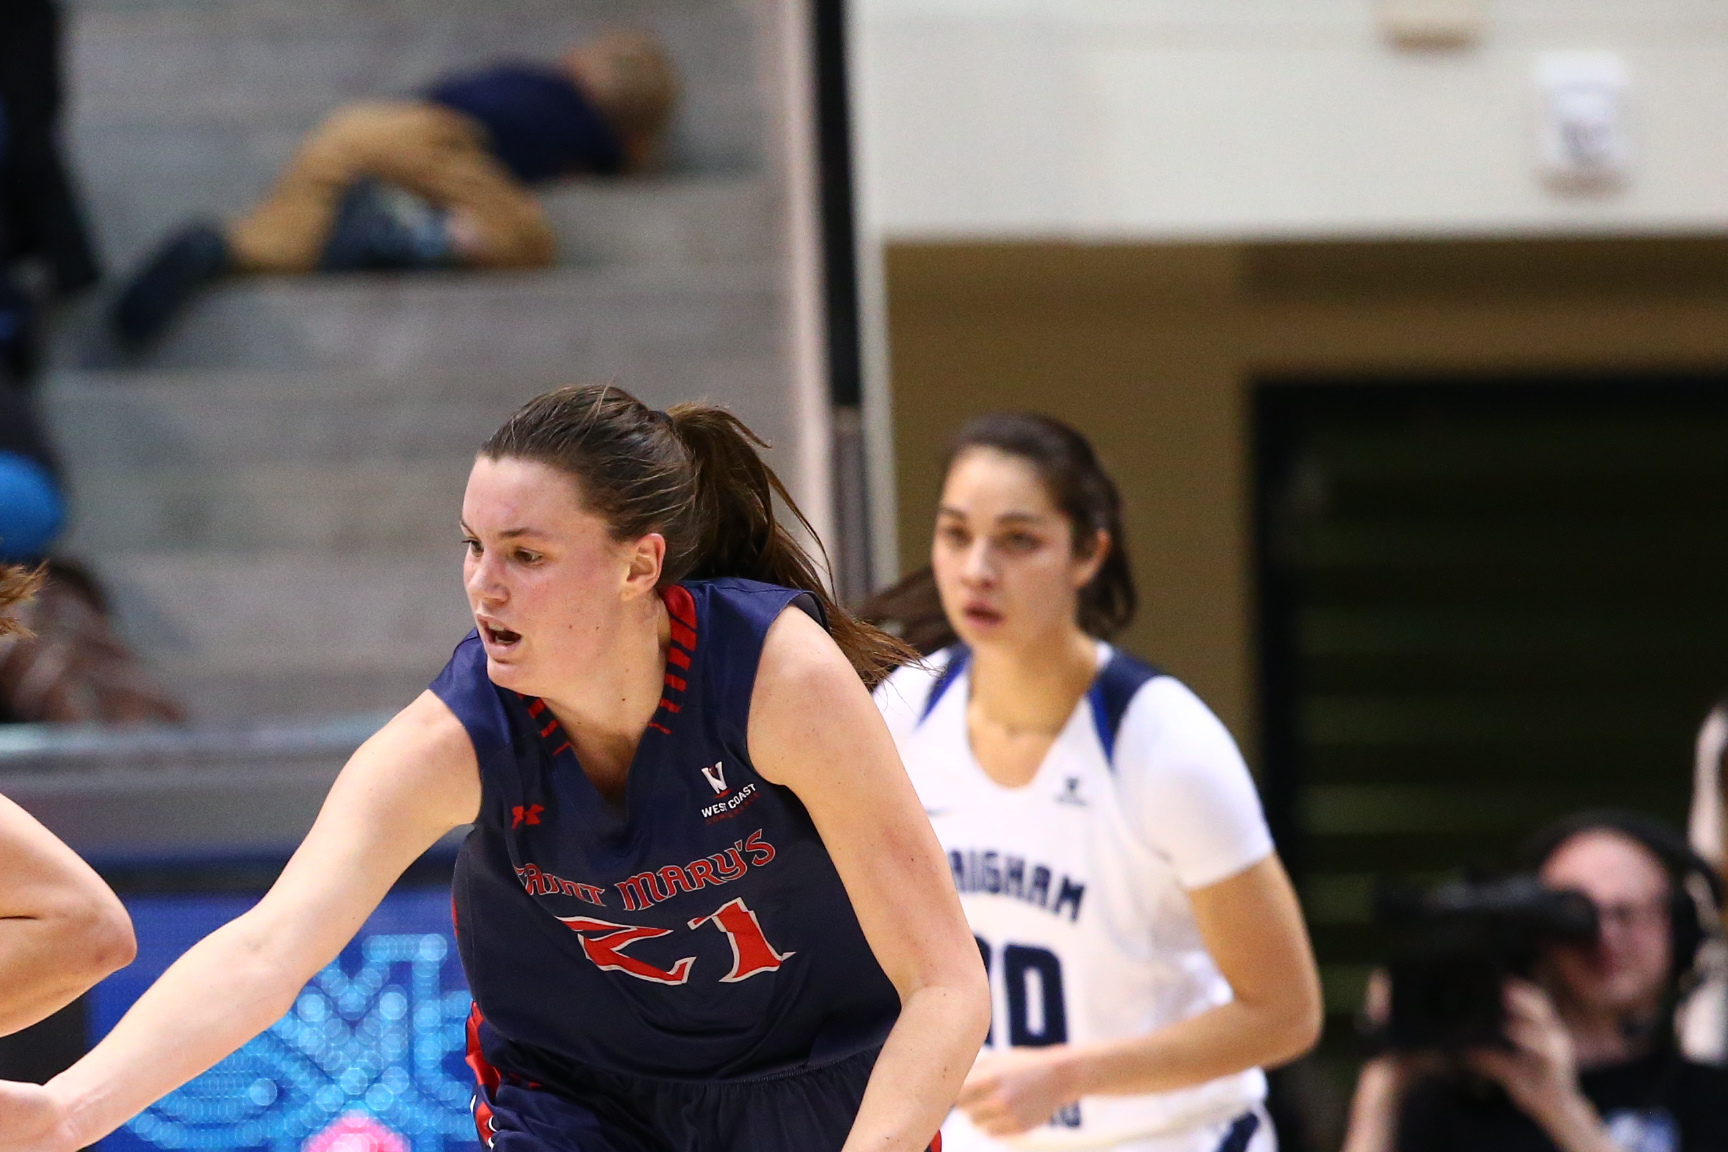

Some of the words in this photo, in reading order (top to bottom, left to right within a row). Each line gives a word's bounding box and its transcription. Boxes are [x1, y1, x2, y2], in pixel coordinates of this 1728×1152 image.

[727, 783, 756, 809] COAST
[613, 828, 776, 911] MARY'S
[554, 896, 797, 986] 21
